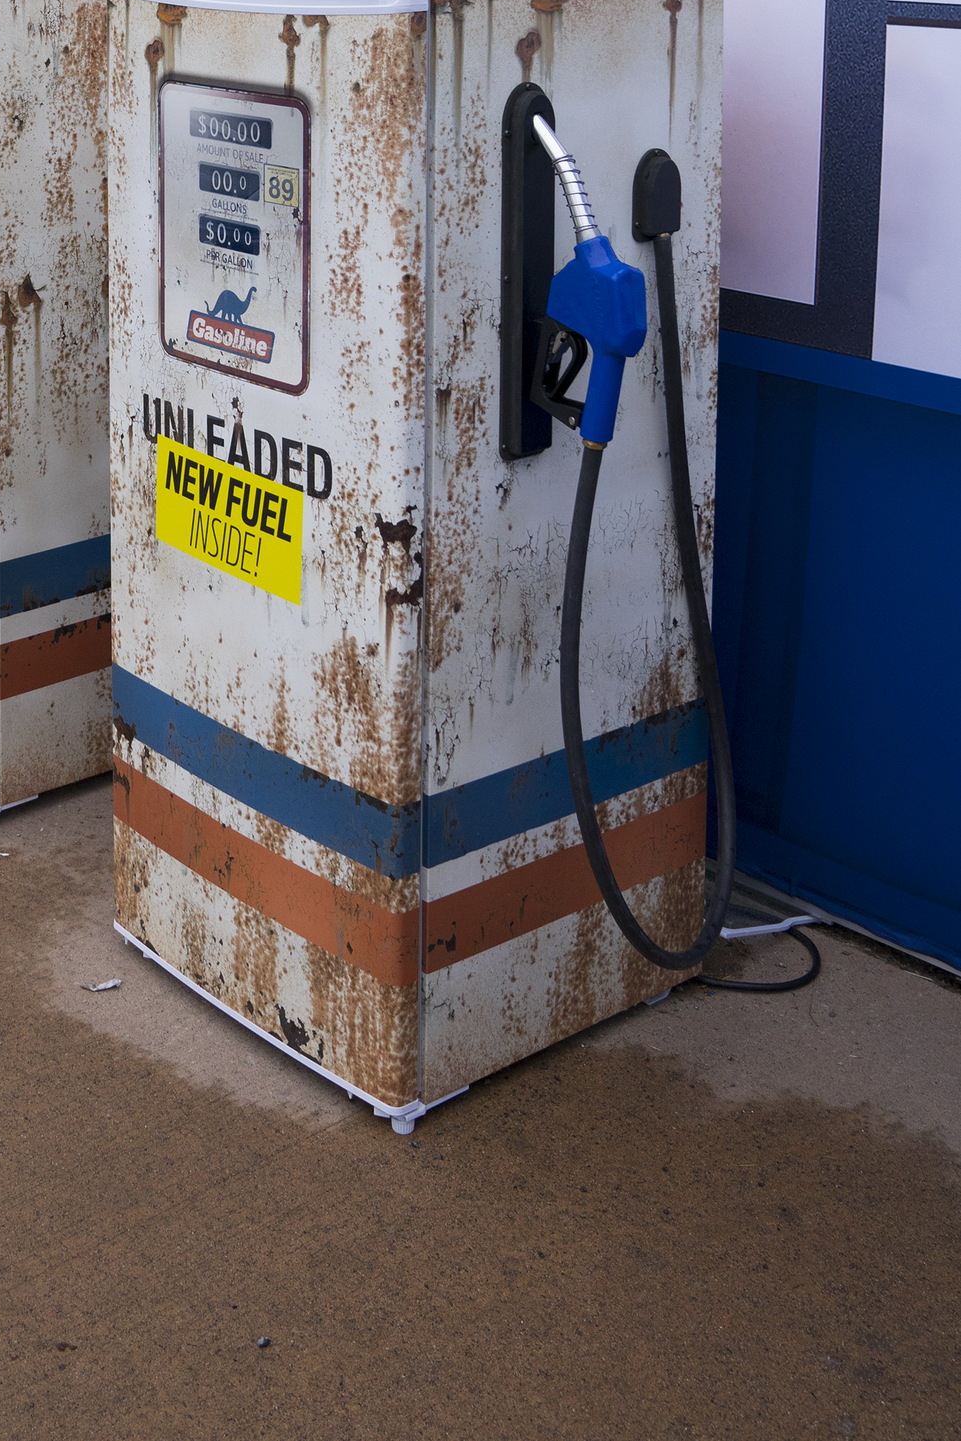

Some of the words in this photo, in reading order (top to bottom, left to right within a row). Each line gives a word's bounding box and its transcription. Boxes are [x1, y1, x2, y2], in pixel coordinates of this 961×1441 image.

[196, 143, 230, 158] AMOUNT
[232, 149, 243, 160] OF
[244, 151, 264, 164] SALE
[212, 170, 247, 194] 00.0
[269, 176, 294, 201] 89
[211, 198, 247, 214] GALLONS
[205, 220, 252, 246] $0.00
[206, 249, 220, 261] PER
[222, 253, 253, 270] GALLON
[192, 317, 268, 357] Gasoline
[165, 450, 224, 511] NEW
[225, 477, 292, 543] FUEL
[189, 508, 262, 578] INSIDE!
